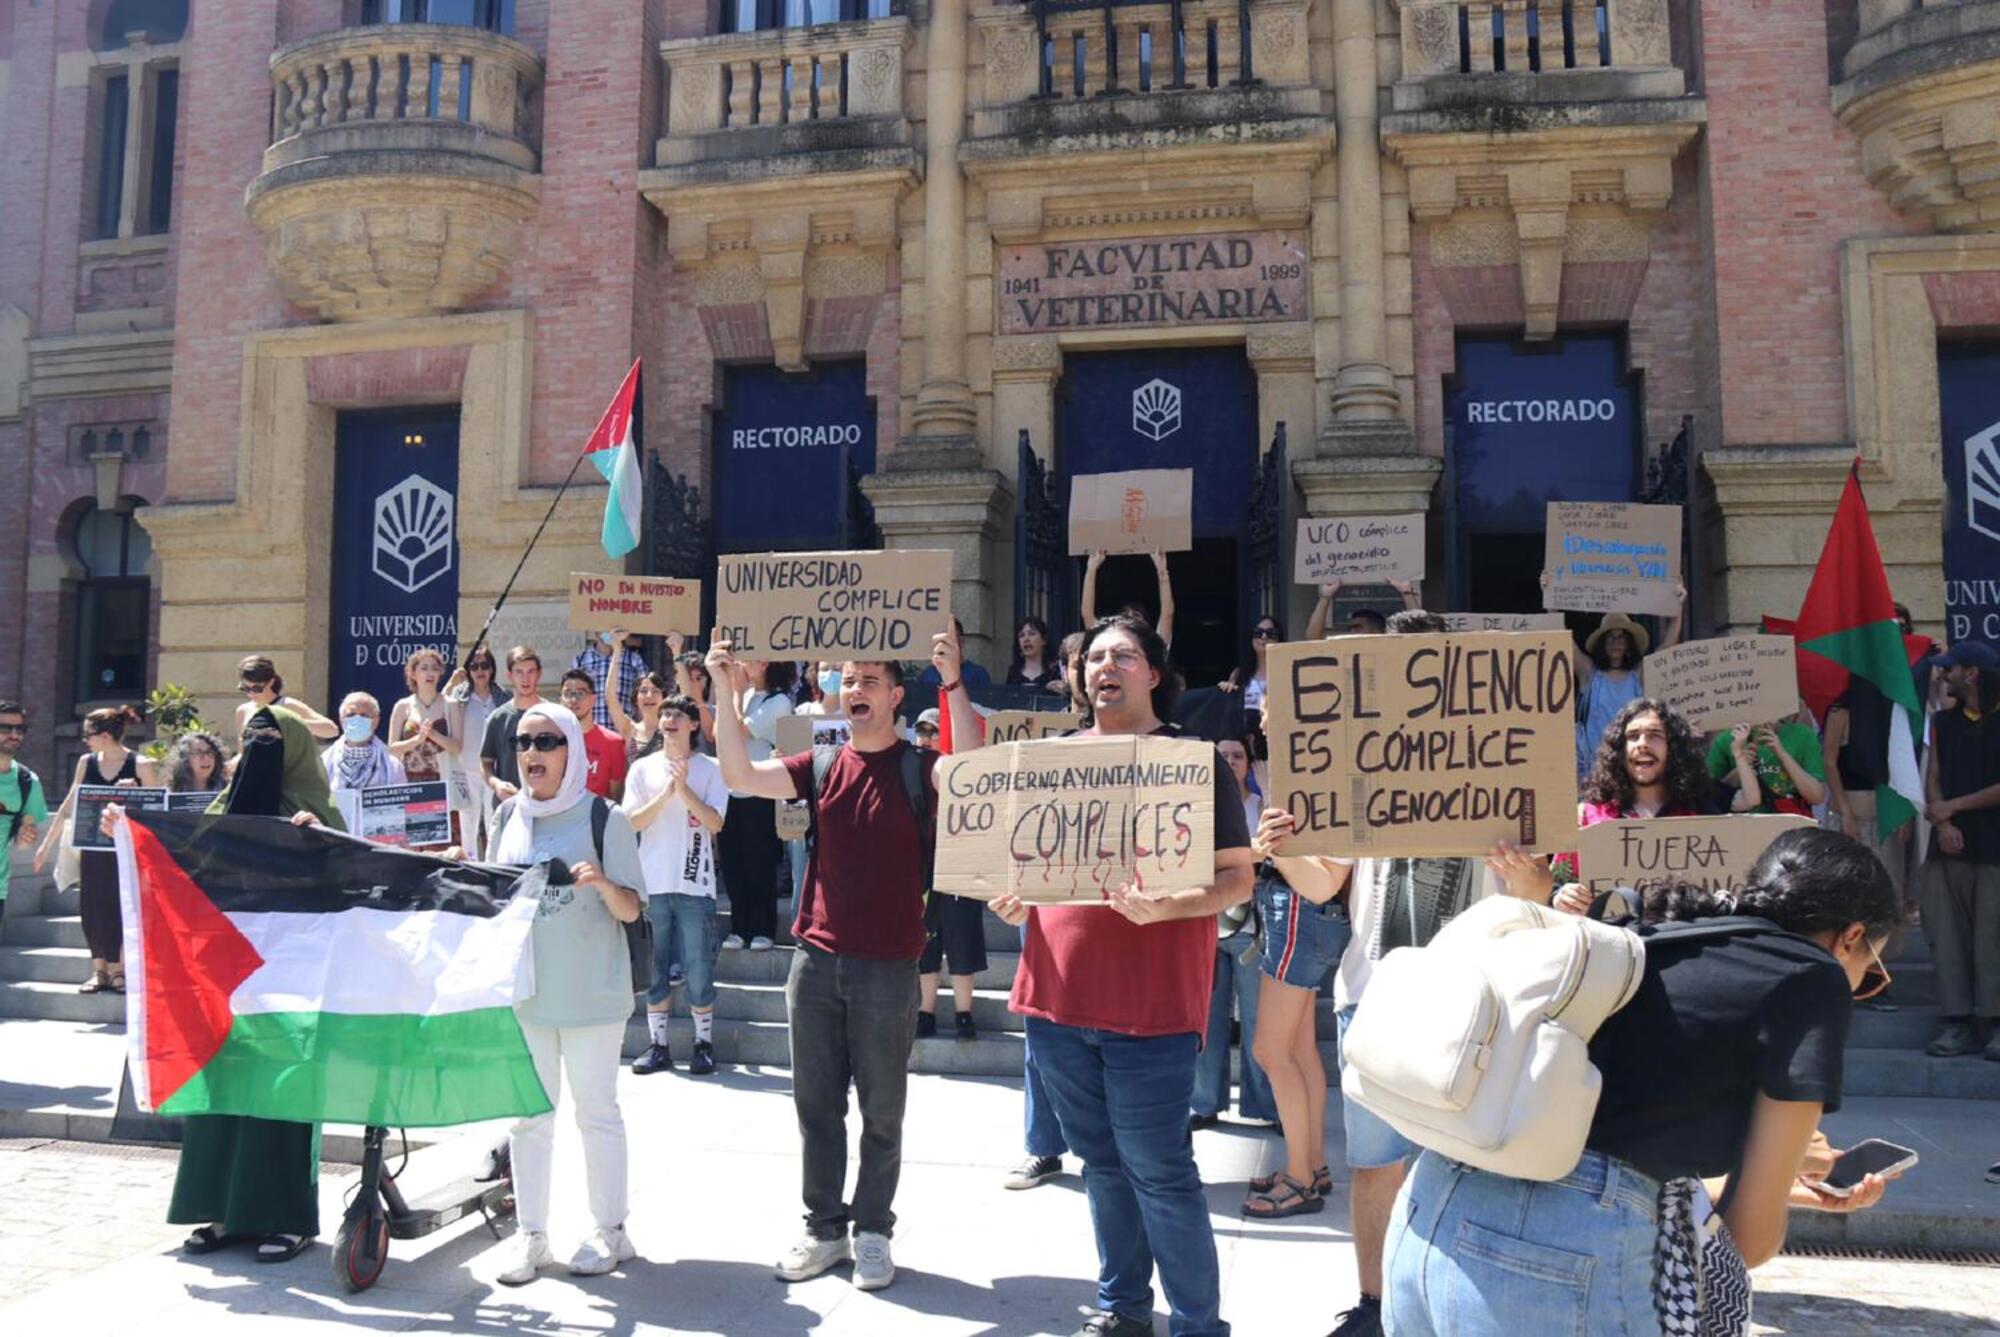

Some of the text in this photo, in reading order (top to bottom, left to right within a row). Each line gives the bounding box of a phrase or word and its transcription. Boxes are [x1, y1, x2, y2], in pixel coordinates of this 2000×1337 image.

[1045, 239, 1254, 278] FACVLTAD
[1005, 278, 1040, 294] 1941
[1134, 275, 1164, 290] DE
[1017, 287, 1286, 327] VETERINARIA
[1467, 399, 1615, 423] RECTORADO
[732, 425, 861, 449] RECTORADO
[1307, 522, 1349, 544] UCO
[1305, 547, 1390, 568] del genocidio
[578, 579, 605, 595] NO
[726, 561, 862, 593] UNIVERSIDAD
[590, 598, 652, 614] NOMBRE
[721, 616, 910, 652] DEL GENOCIDIO
[1484, 618, 1528, 630] DE LA
[1293, 640, 1572, 722] EL SILENCIO
[1290, 729, 1332, 774] ES
[947, 801, 994, 835] UCO
[1289, 791, 1349, 835] DEL
[1366, 782, 1526, 826] GENOCIDIO
[1618, 826, 1728, 870] FUERA
